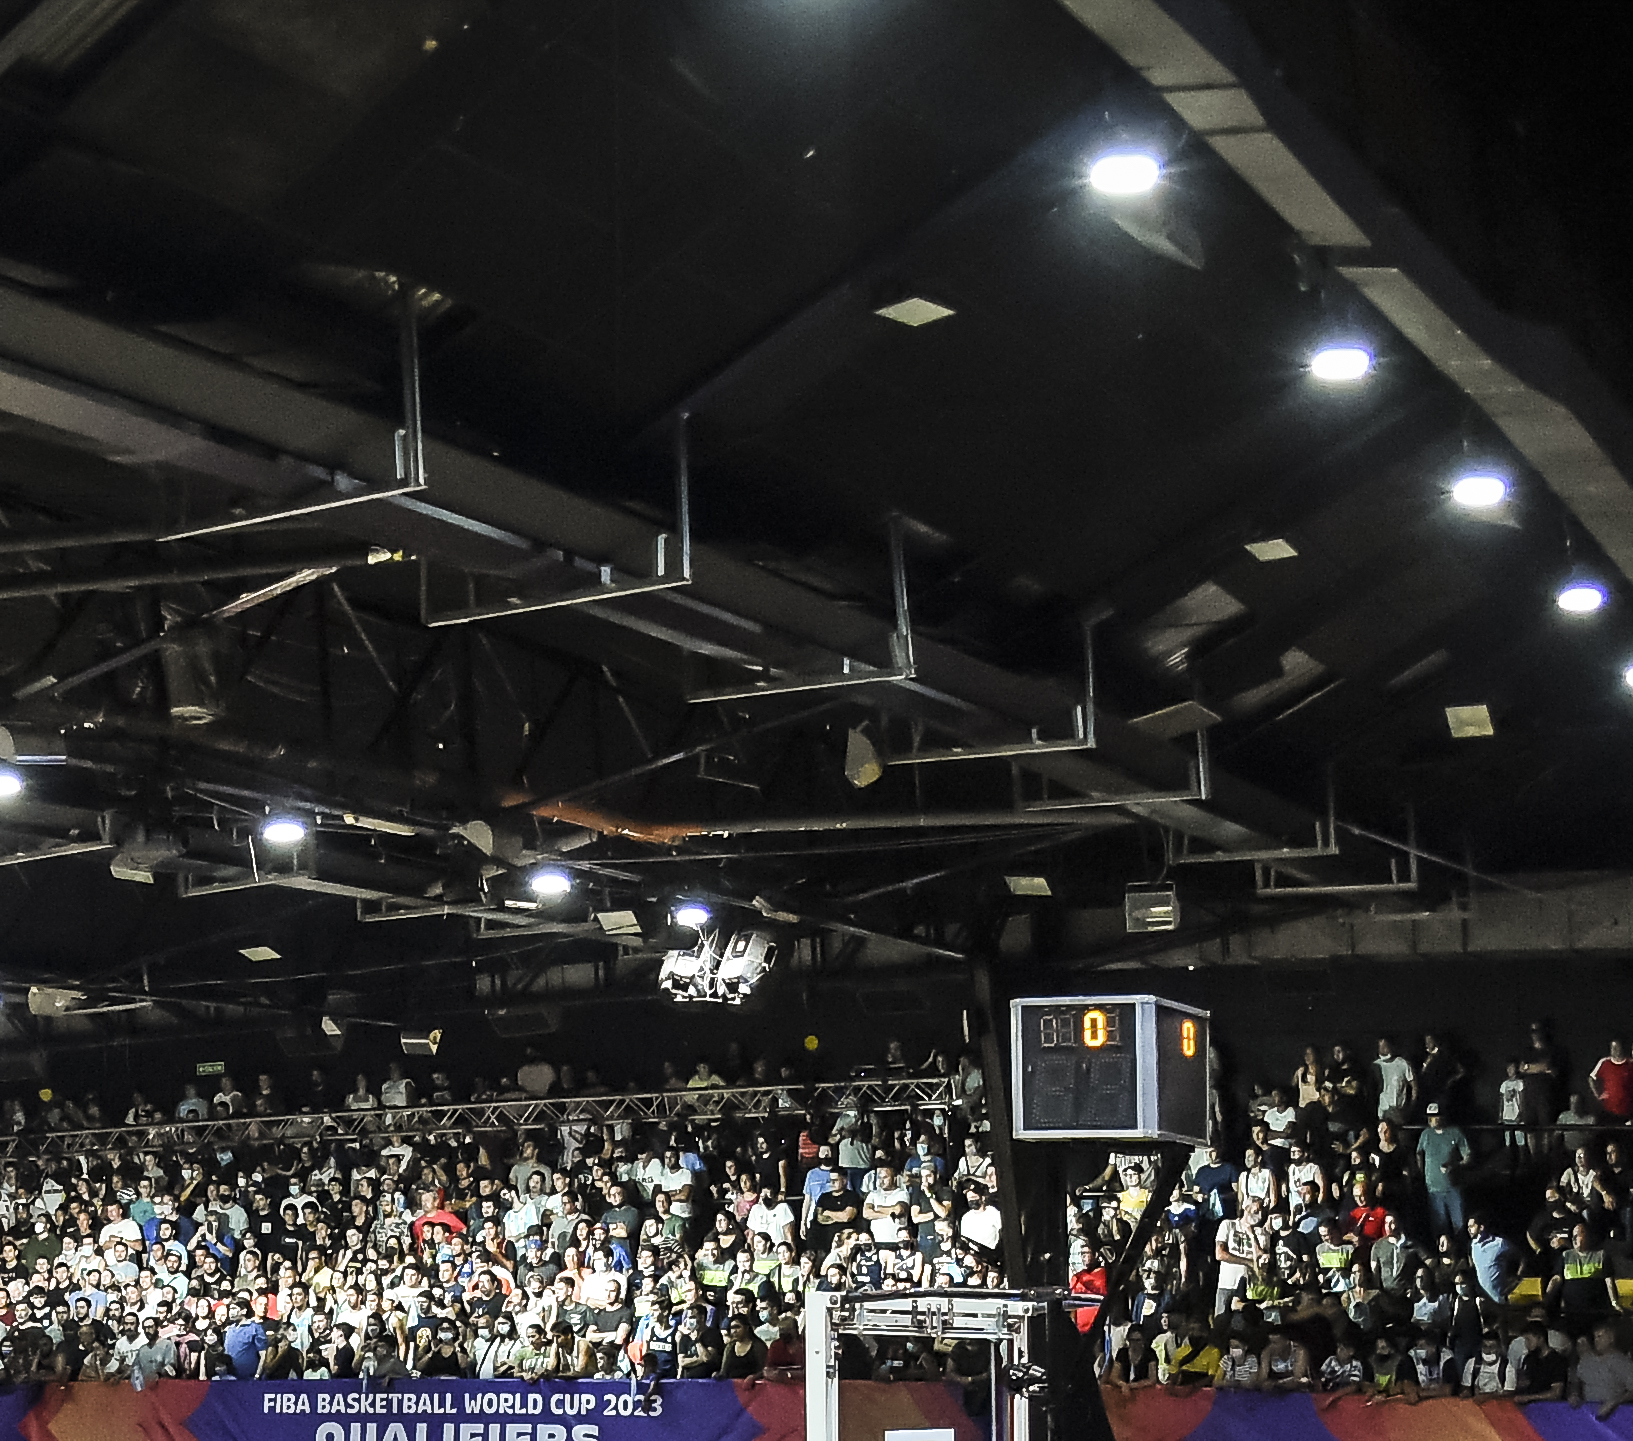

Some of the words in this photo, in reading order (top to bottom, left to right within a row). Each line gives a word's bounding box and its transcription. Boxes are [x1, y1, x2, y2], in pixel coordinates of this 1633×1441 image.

[263, 1393, 311, 1414] FIBA
[317, 1393, 457, 1415] BASKETBALL
[464, 1393, 543, 1415] WORLD
[549, 1396, 596, 1416] CUP
